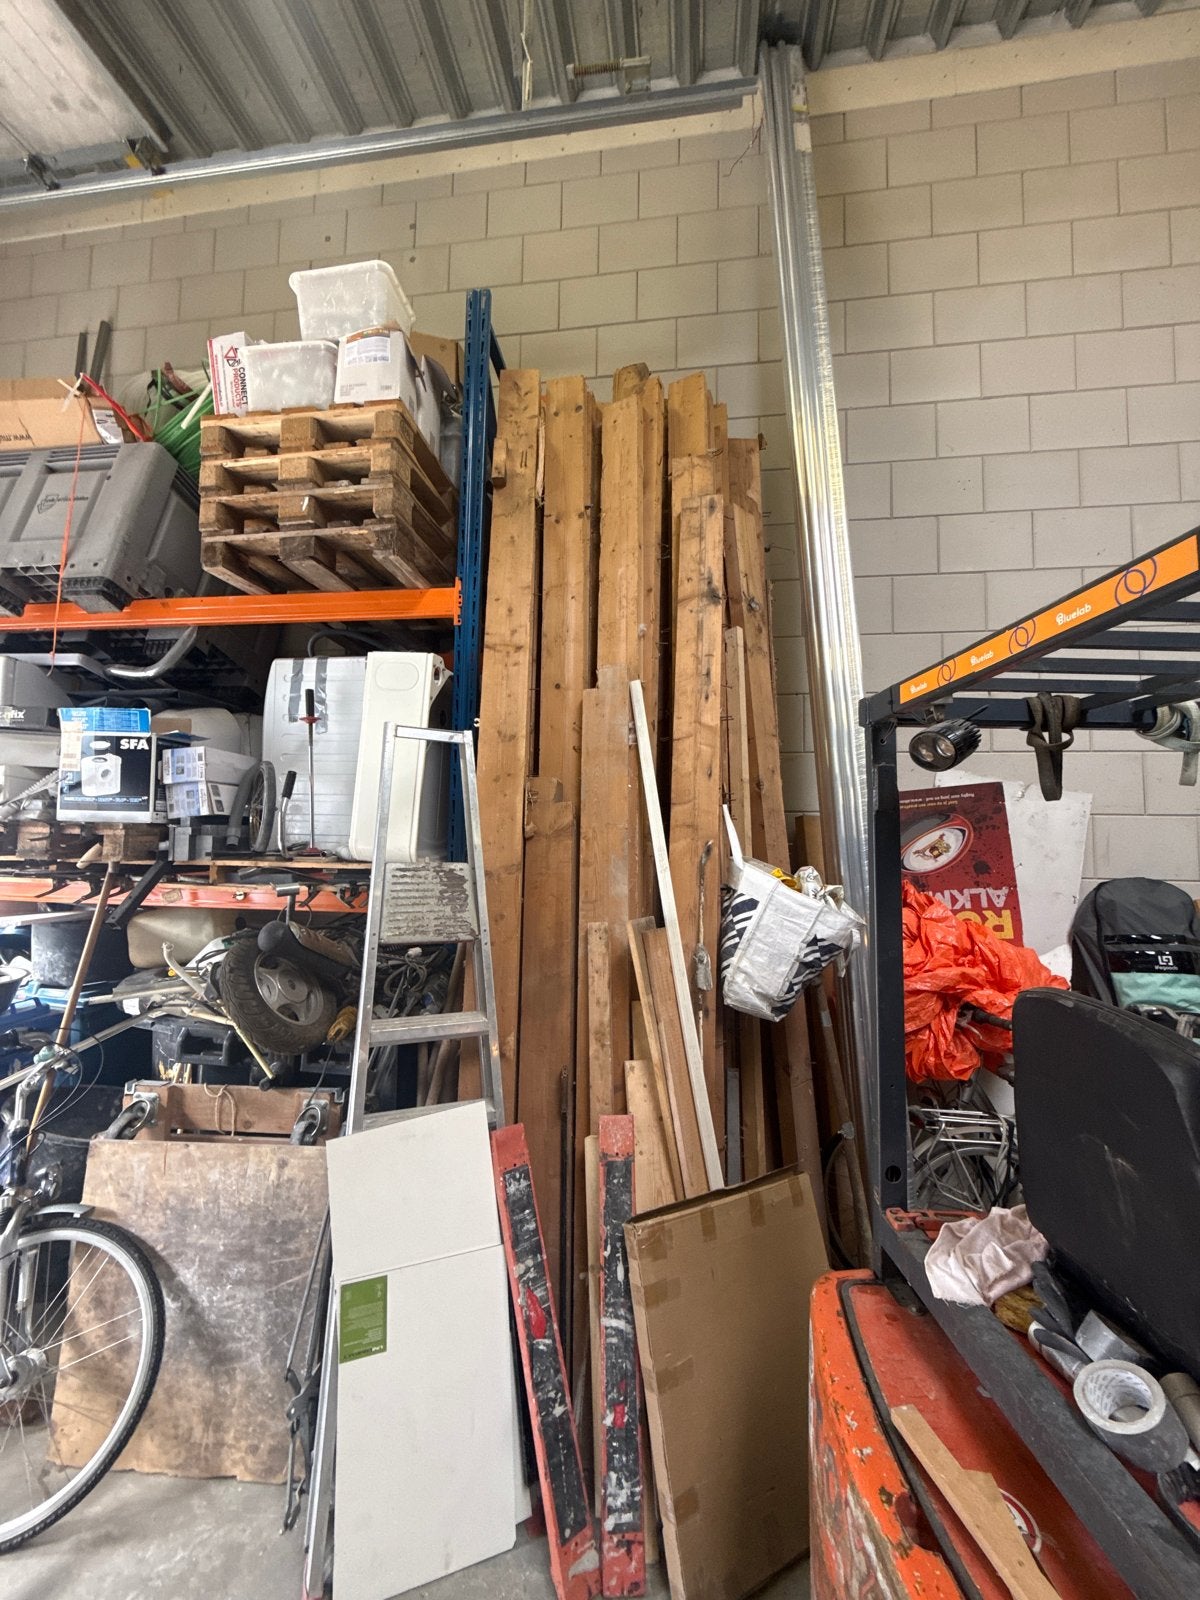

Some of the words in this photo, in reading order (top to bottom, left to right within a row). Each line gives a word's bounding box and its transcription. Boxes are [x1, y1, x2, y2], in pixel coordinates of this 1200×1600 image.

[232, 367, 242, 408] PRODUCTS
[238, 366, 249, 405] CONNECT
[1055, 603, 1092, 626] Bluelab
[120, 738, 149, 750] SFA
[919, 886, 1009, 910] ALKM
